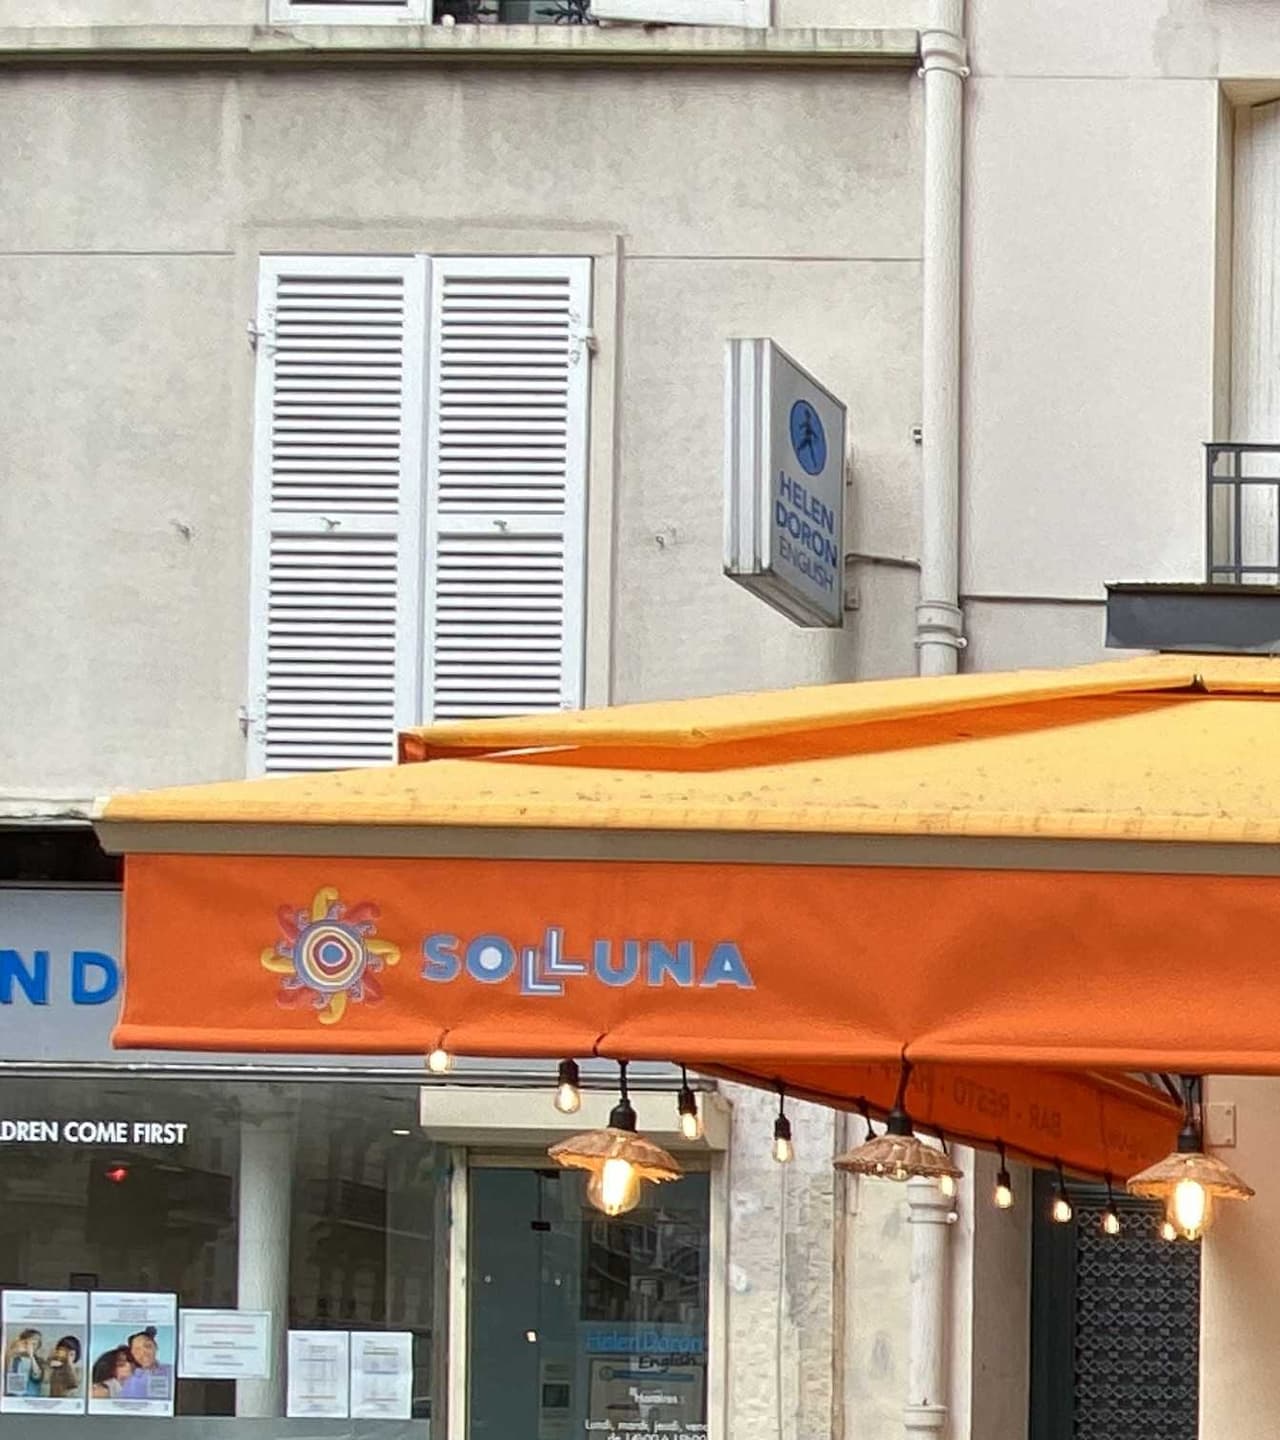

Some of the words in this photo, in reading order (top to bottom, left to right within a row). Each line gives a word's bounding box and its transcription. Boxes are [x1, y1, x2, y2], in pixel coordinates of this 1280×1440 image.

[776, 500, 837, 568] DORON
[780, 470, 833, 534] HELEN
[779, 535, 833, 592] ENGLISH
[421, 926, 756, 996] SOLLUNA
[0, 1120, 58, 1142] DREN
[64, 1121, 128, 1144] COME
[133, 1122, 188, 1145] FIRST
